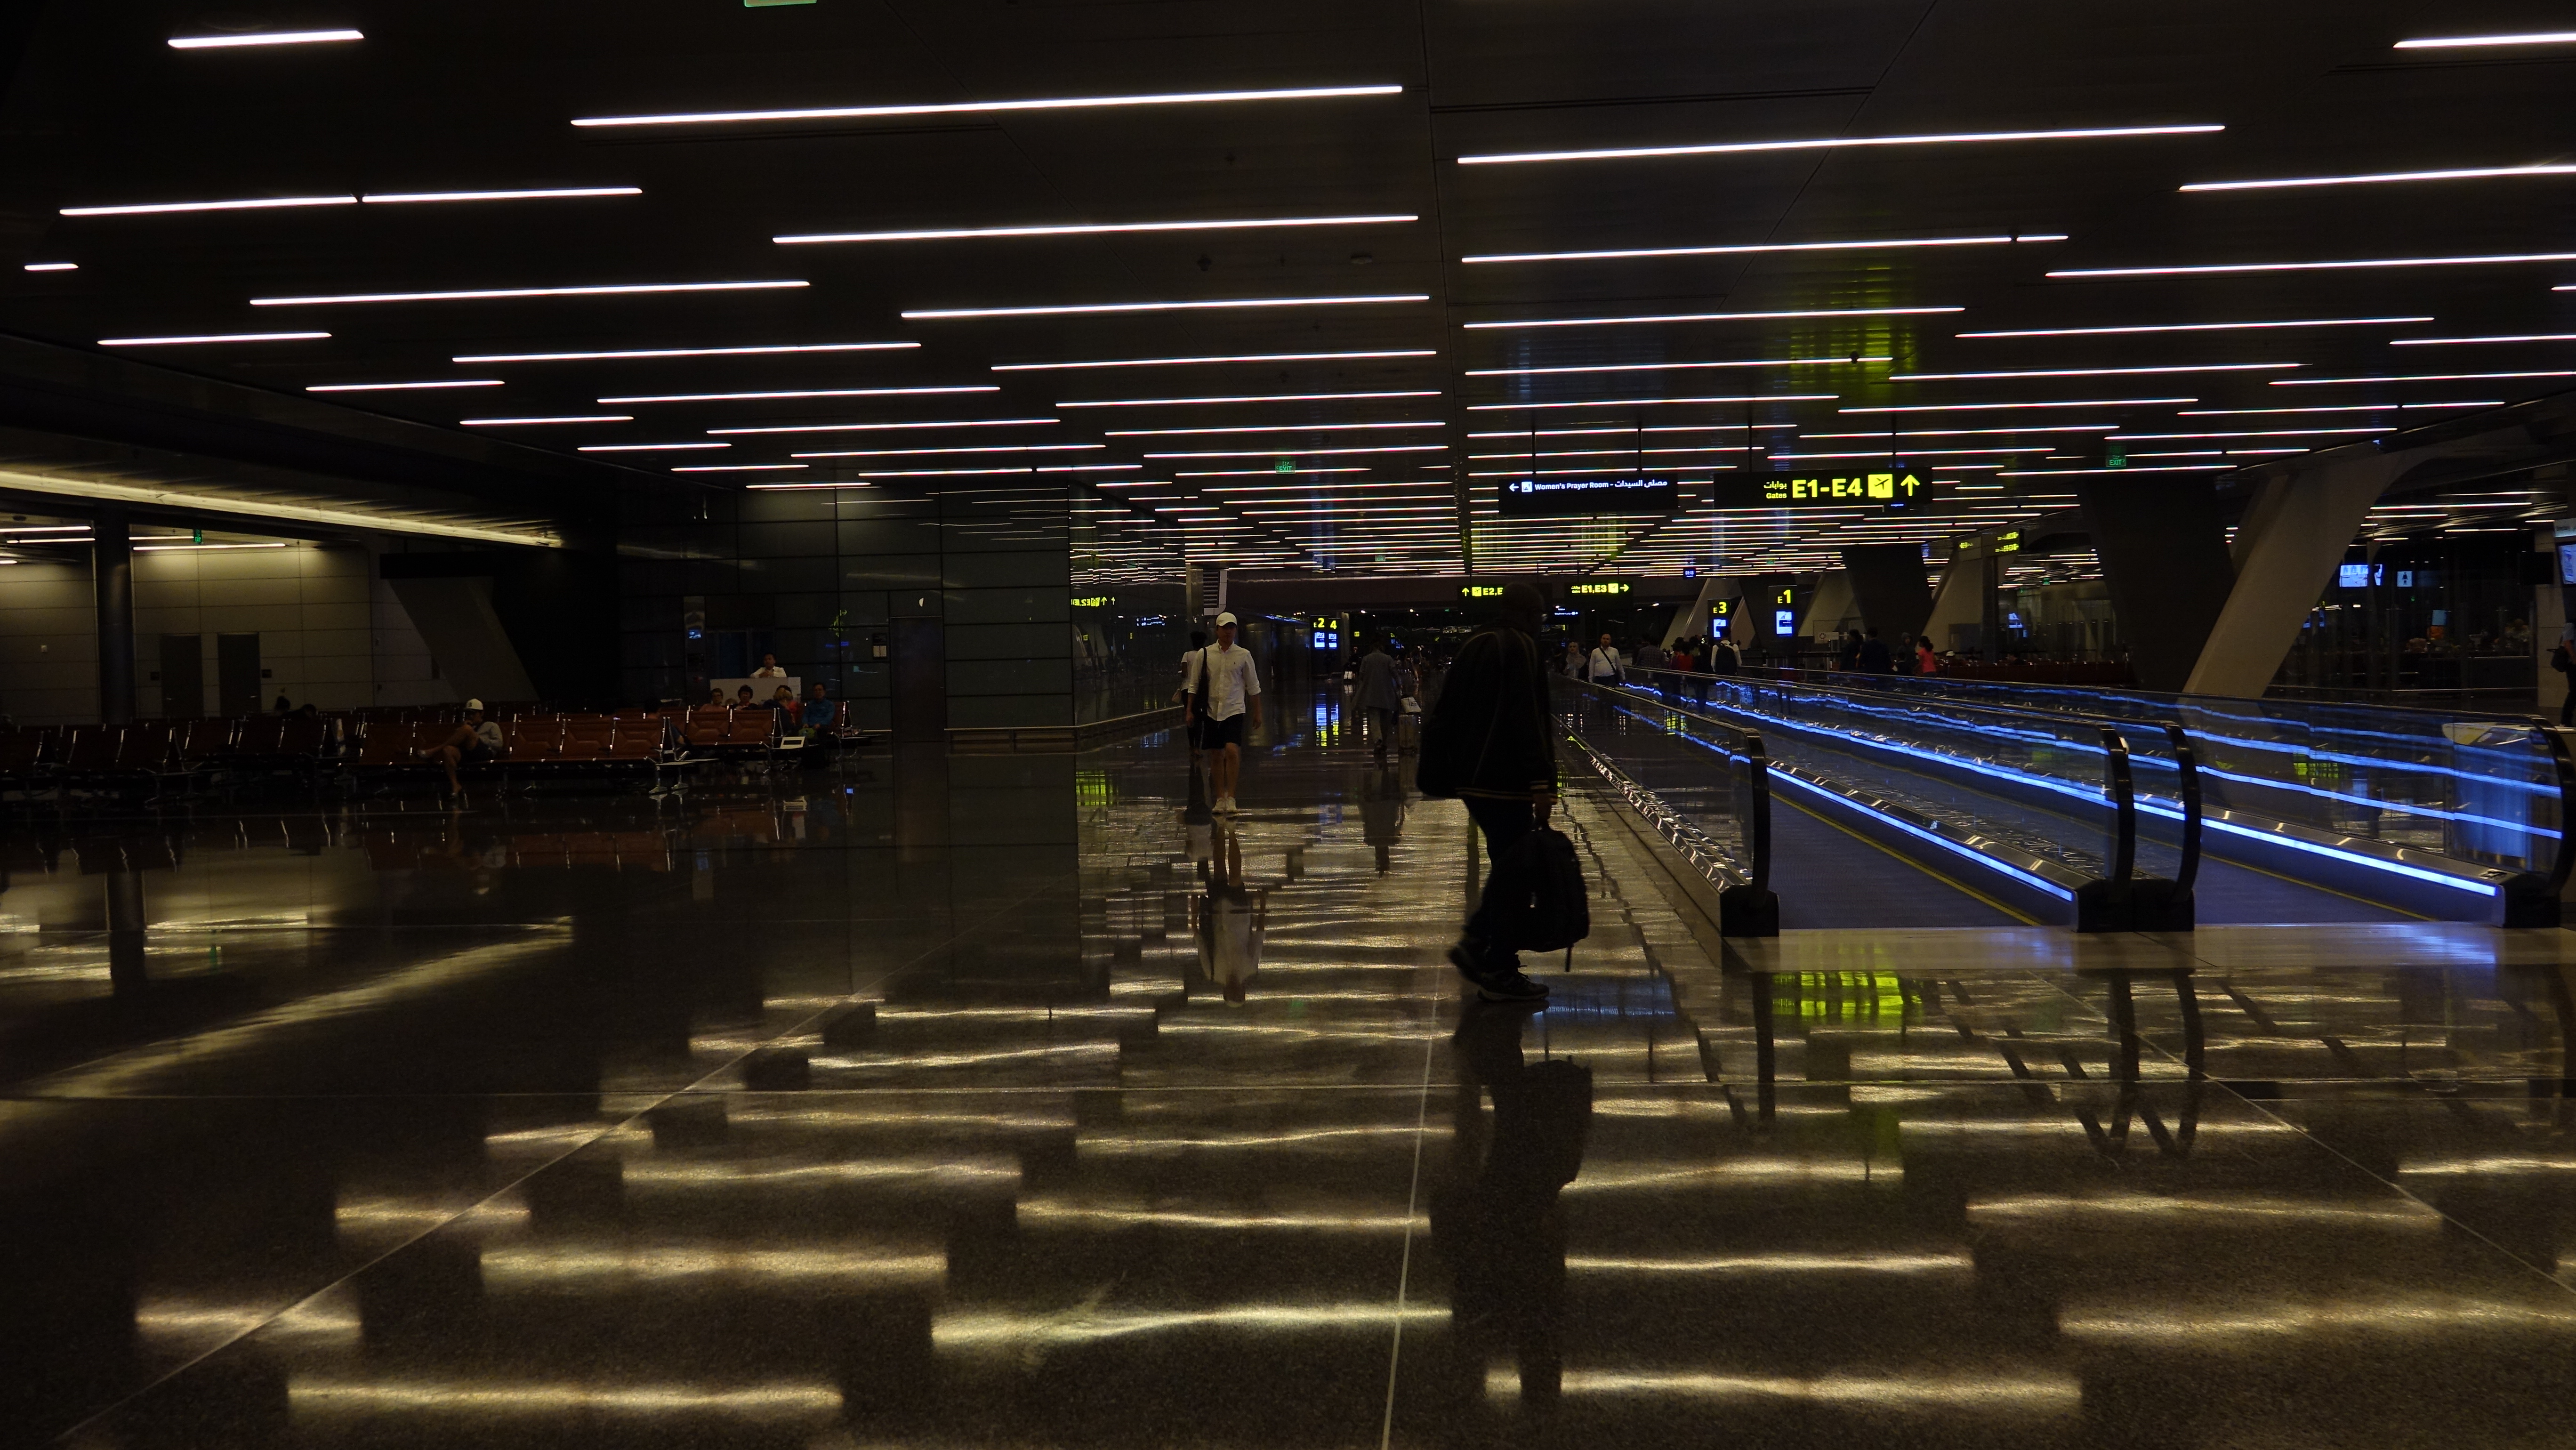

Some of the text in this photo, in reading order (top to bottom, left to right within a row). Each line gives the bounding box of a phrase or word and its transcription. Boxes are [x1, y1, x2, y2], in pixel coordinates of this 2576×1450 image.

[1567, 483, 1588, 491] Prayer
[1615, 480, 1643, 489] السيدات
[1763, 481, 1787, 490] بوابات
[1792, 478, 1863, 498] E1-E4
[1582, 585, 1607, 593] E1,E3
